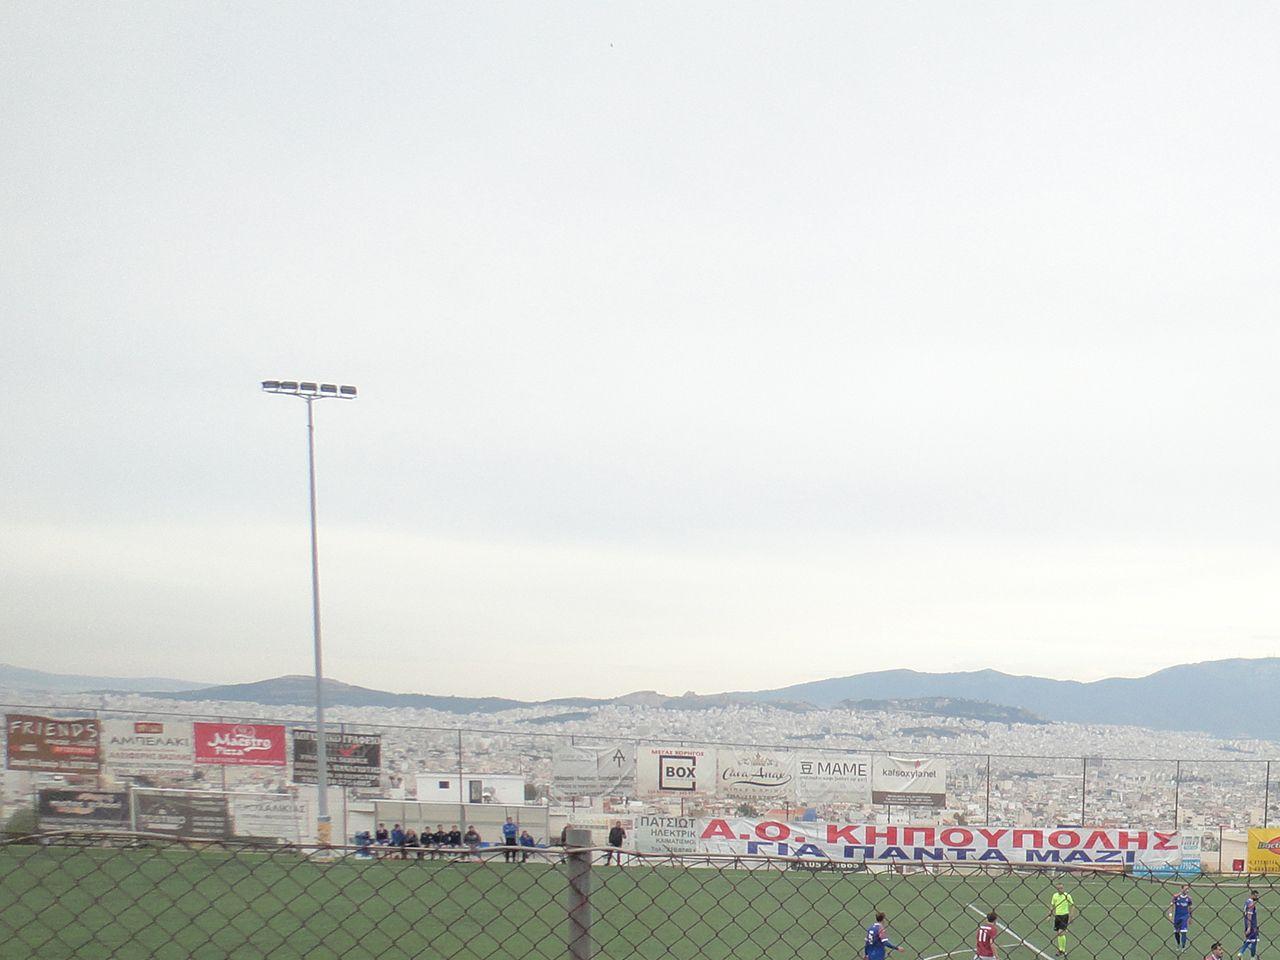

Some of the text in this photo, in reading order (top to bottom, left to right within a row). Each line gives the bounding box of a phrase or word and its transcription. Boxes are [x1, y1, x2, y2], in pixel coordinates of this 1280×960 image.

[10, 721, 98, 737] FRIENDS
[110, 737, 190, 747] ΑΜΠΕΛΑΚΙ
[207, 733, 272, 751] Maestro
[666, 766, 696, 778] BOX
[817, 762, 867, 776] MAME
[700, 818, 806, 843] Α.Ο.
[826, 824, 1180, 850] ΚΗΠΟΥΠΟΛΗΣ
[747, 841, 1136, 863] ΓΙΑ ΠΑΝΤΑ ΜΑΖΙ
